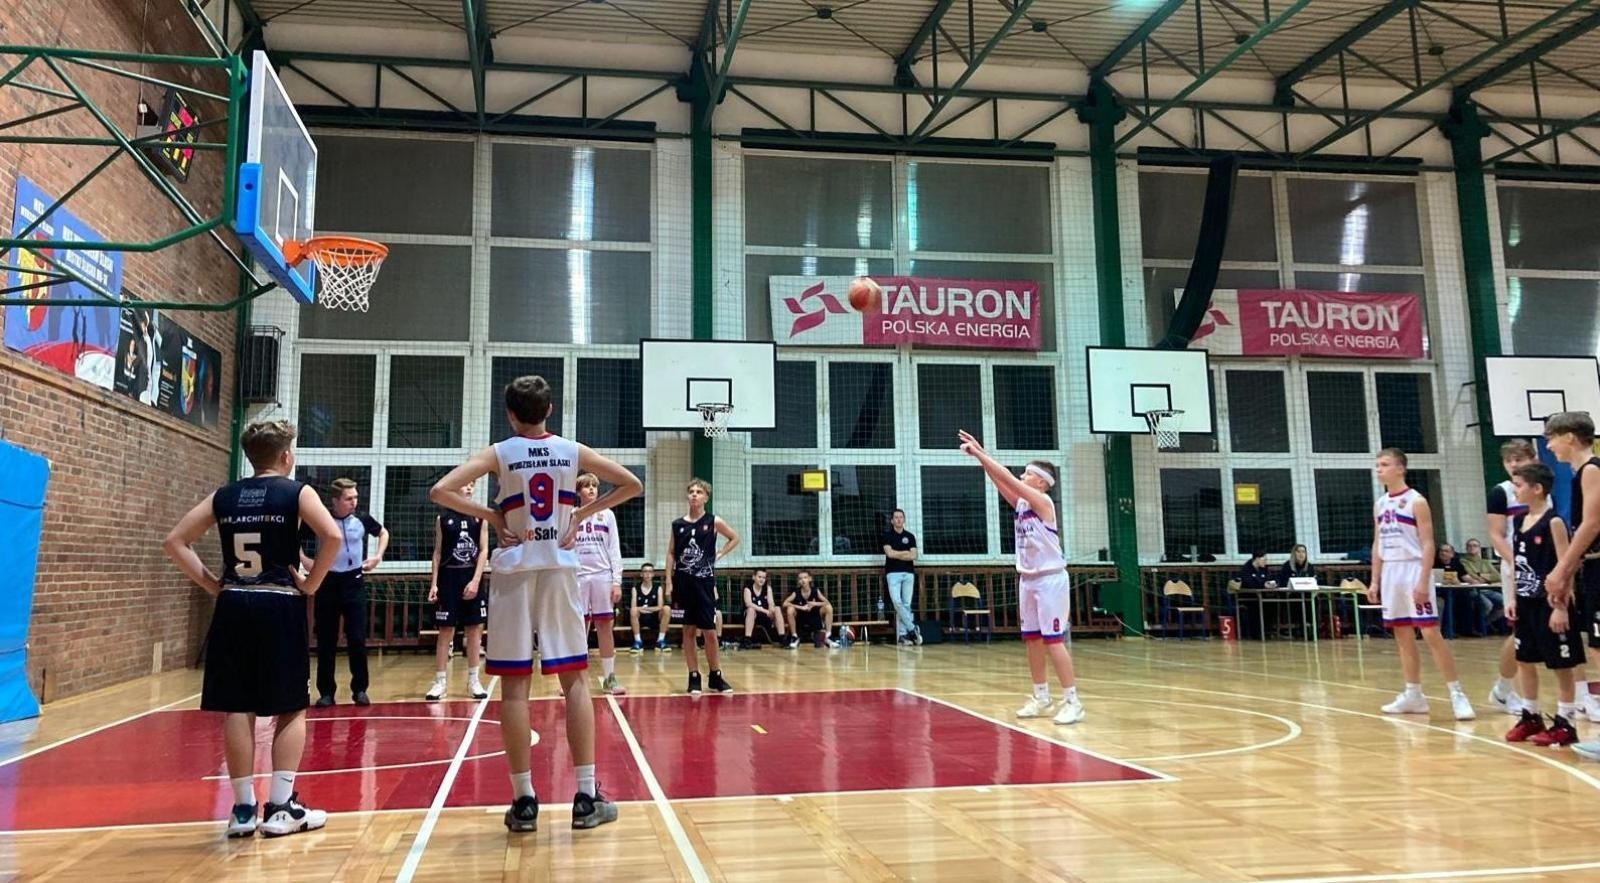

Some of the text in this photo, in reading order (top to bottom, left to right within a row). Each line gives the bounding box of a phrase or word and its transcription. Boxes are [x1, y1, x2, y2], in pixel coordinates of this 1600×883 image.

[879, 284, 1032, 321] TAURON
[1260, 300, 1400, 332] TAURON
[882, 319, 1031, 340] POLSKA ENERGIA
[1269, 332, 1400, 350] POLSKA ENERGIA
[528, 447, 550, 458] MKS
[529, 472, 554, 522] 9
[233, 532, 263, 578] 5
[1053, 617, 1060, 632] 8
[1222, 618, 1231, 634] 5
[1559, 644, 1570, 658] 2
